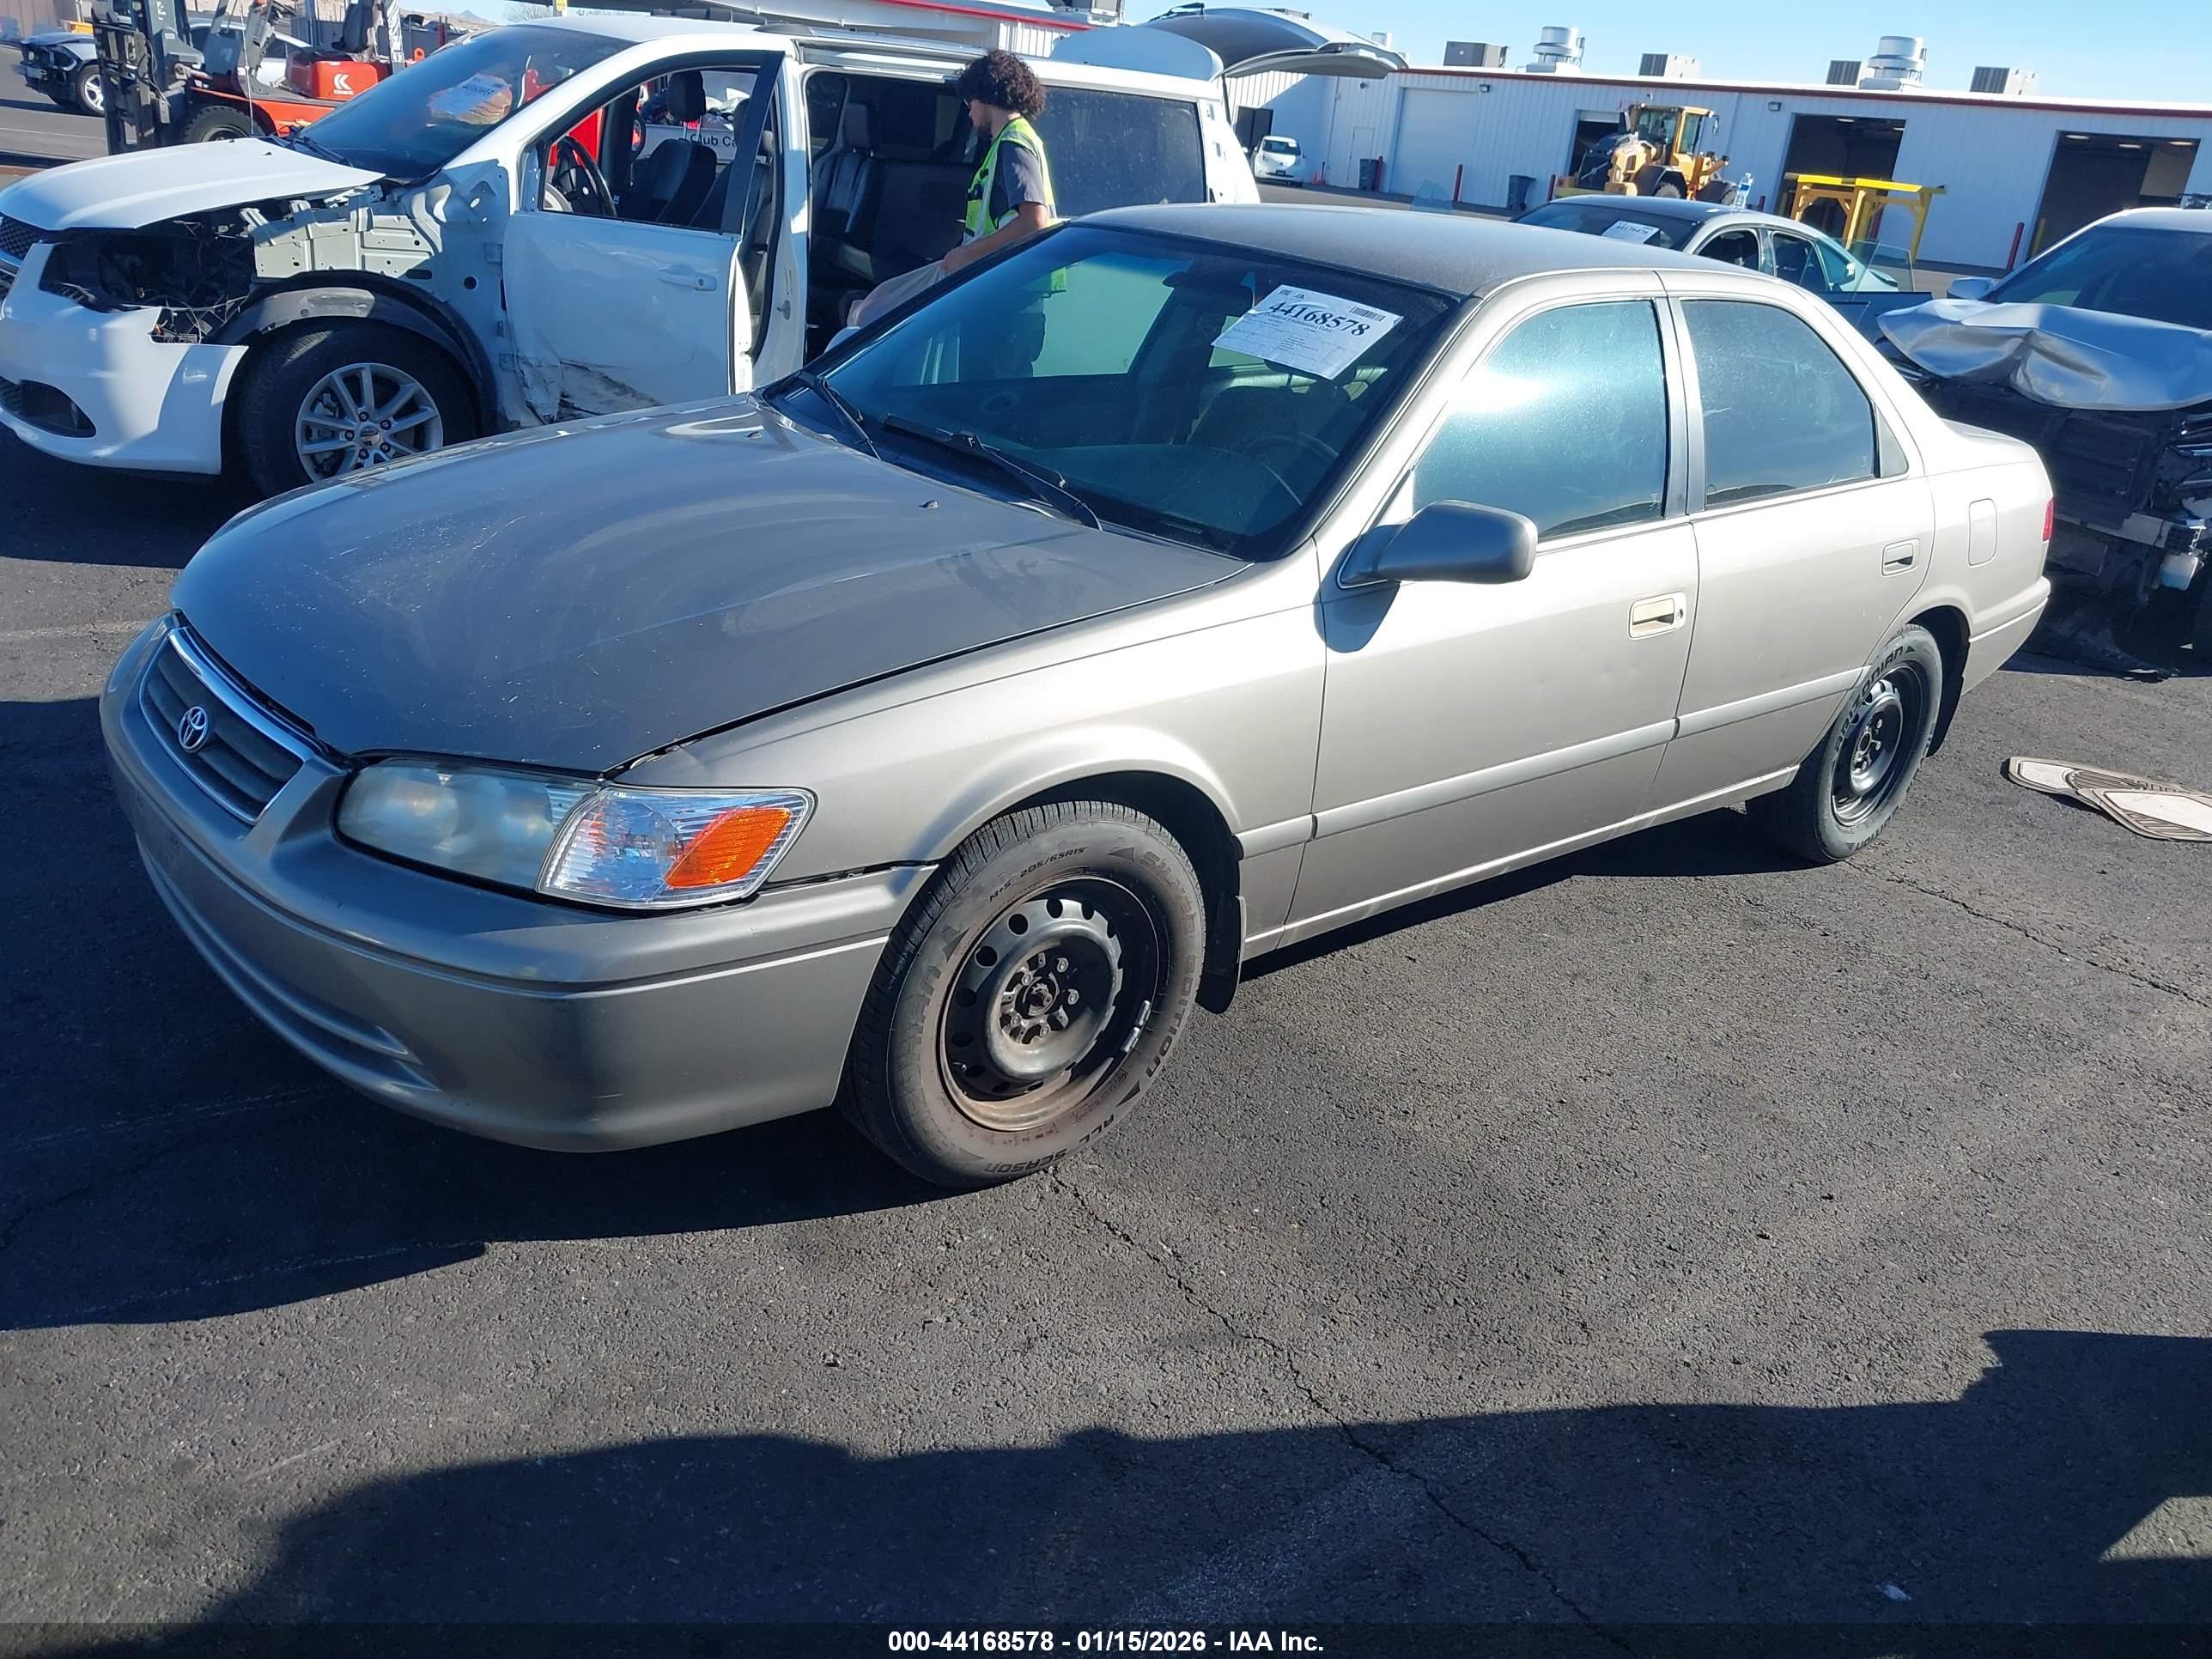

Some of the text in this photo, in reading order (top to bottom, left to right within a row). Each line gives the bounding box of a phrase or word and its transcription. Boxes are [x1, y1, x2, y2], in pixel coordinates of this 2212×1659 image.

[1269, 301, 1370, 336] 44168578
[1020, 847, 1089, 877] 205/65R15
[1079, 1113, 1115, 1144] ALL
[984, 1147, 1068, 1173] SEASON
